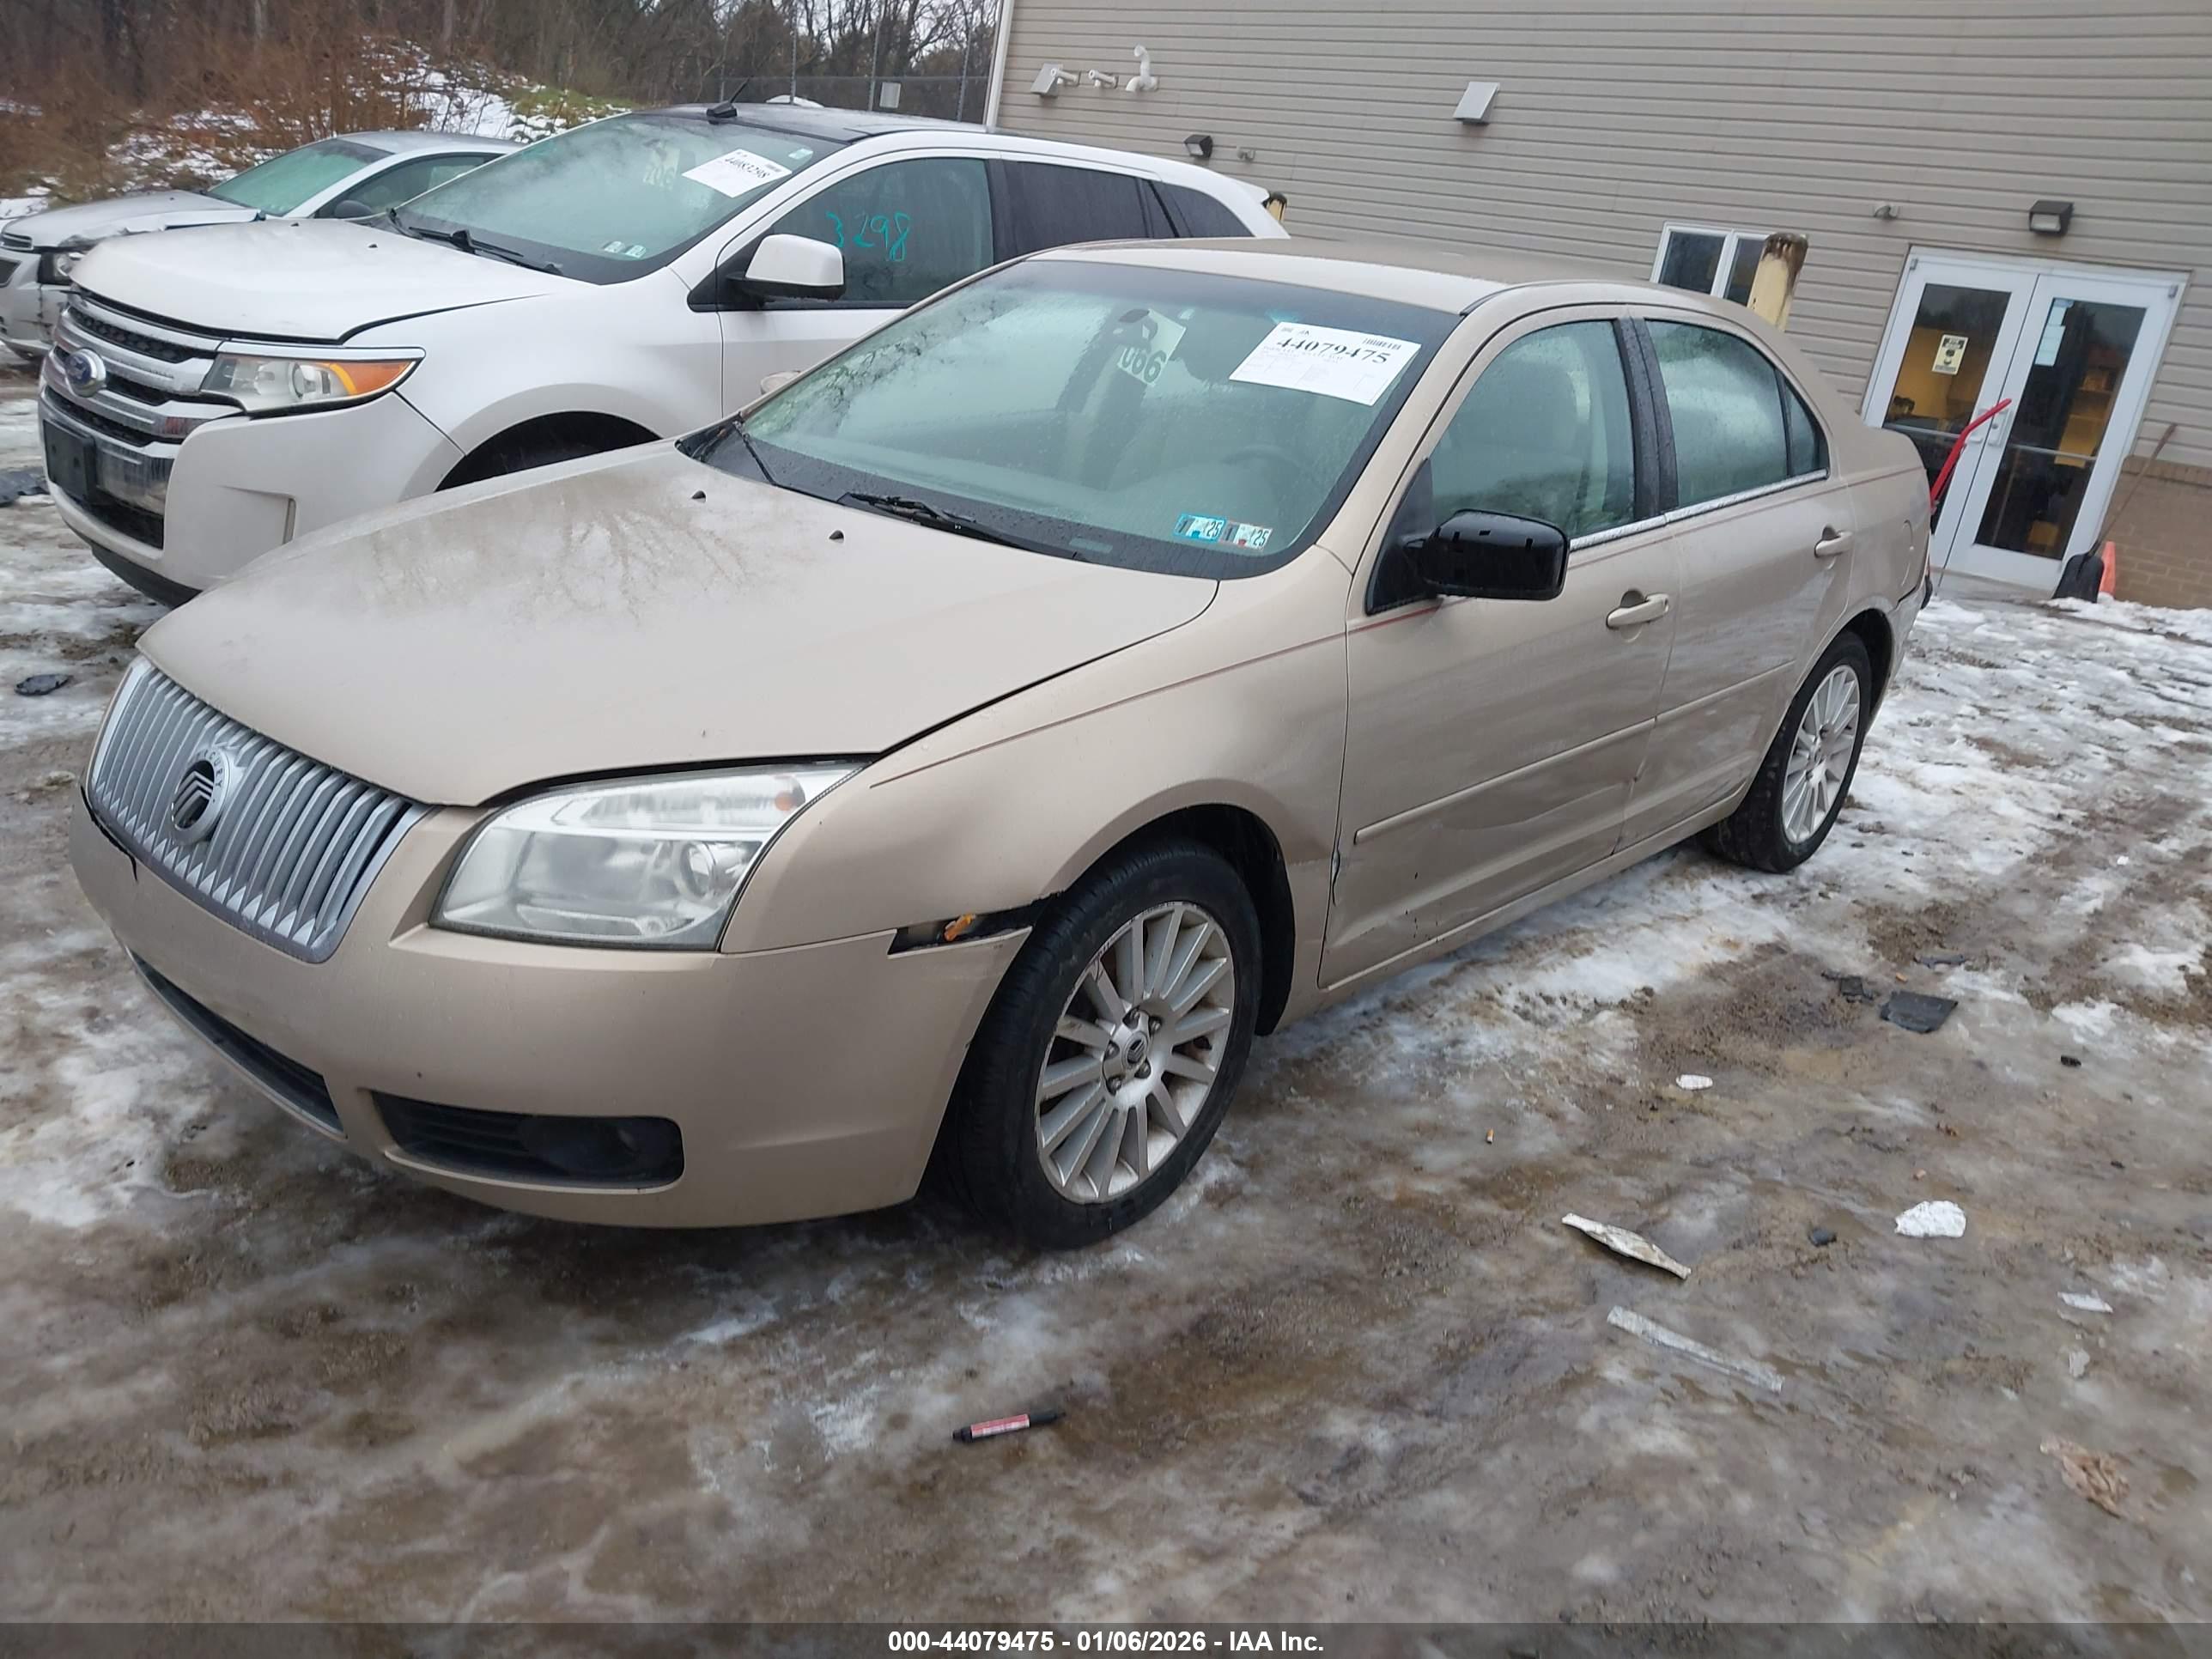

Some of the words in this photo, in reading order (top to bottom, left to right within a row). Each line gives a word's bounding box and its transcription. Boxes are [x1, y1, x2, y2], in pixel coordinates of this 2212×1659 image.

[825, 211, 910, 262] 3298
[1277, 337, 1391, 364] 44079475
[1206, 520, 1223, 538] 25
[1254, 529, 1269, 547] 25
